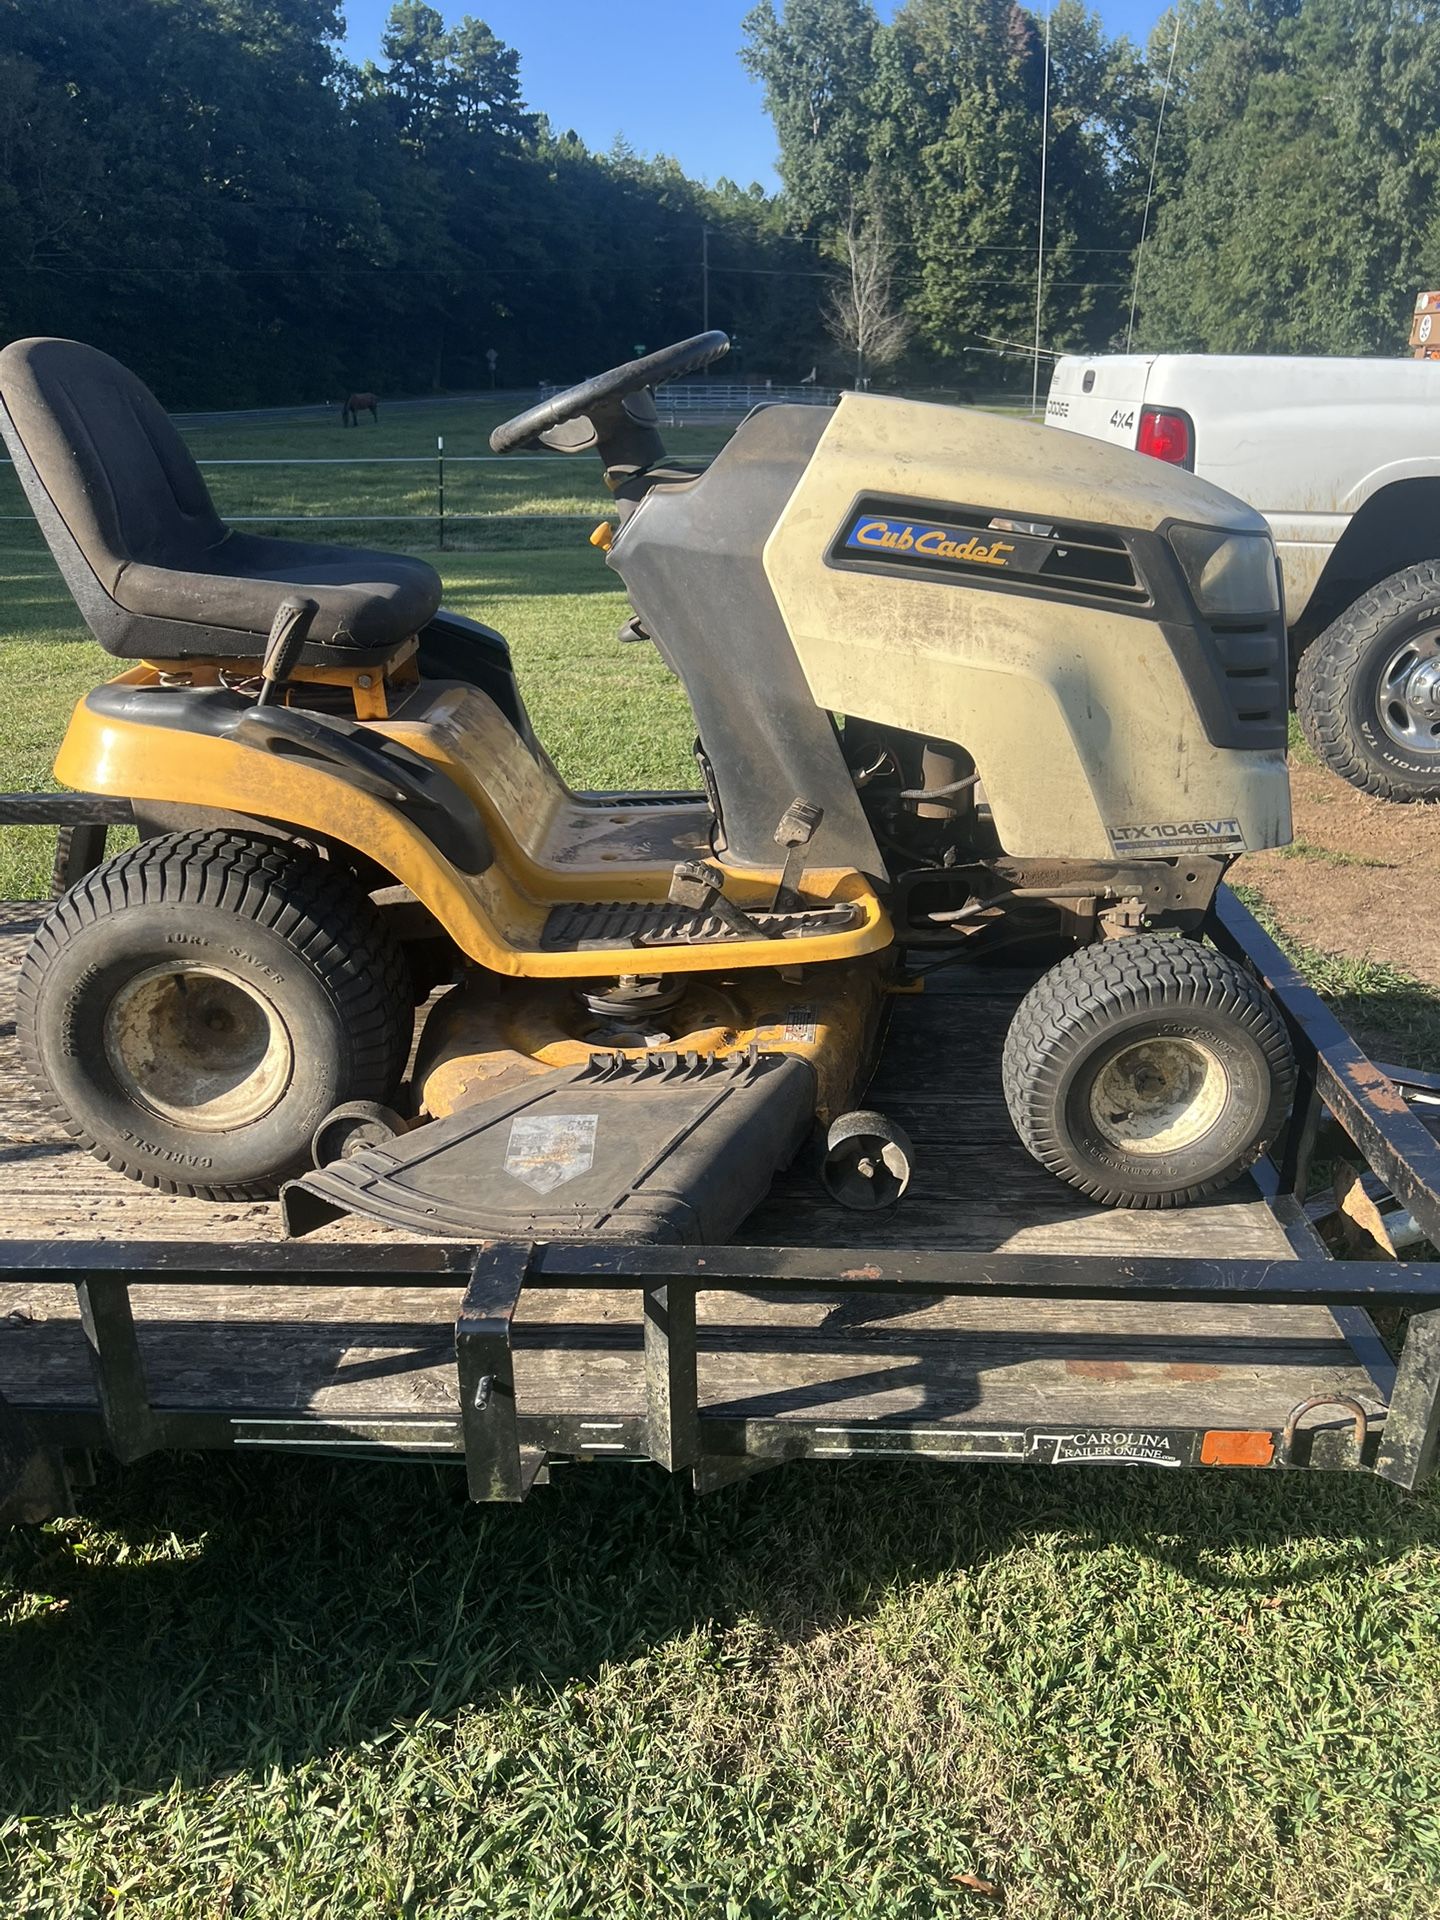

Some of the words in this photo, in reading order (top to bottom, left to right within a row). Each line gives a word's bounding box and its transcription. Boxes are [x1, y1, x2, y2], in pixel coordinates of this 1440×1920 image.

[857, 522, 914, 550] Cub
[915, 532, 1015, 565] Cadet
[227, 944, 285, 985] SAVER
[120, 1129, 213, 1168] CARLISLE
[1073, 1432, 1170, 1450] CAROLINA
